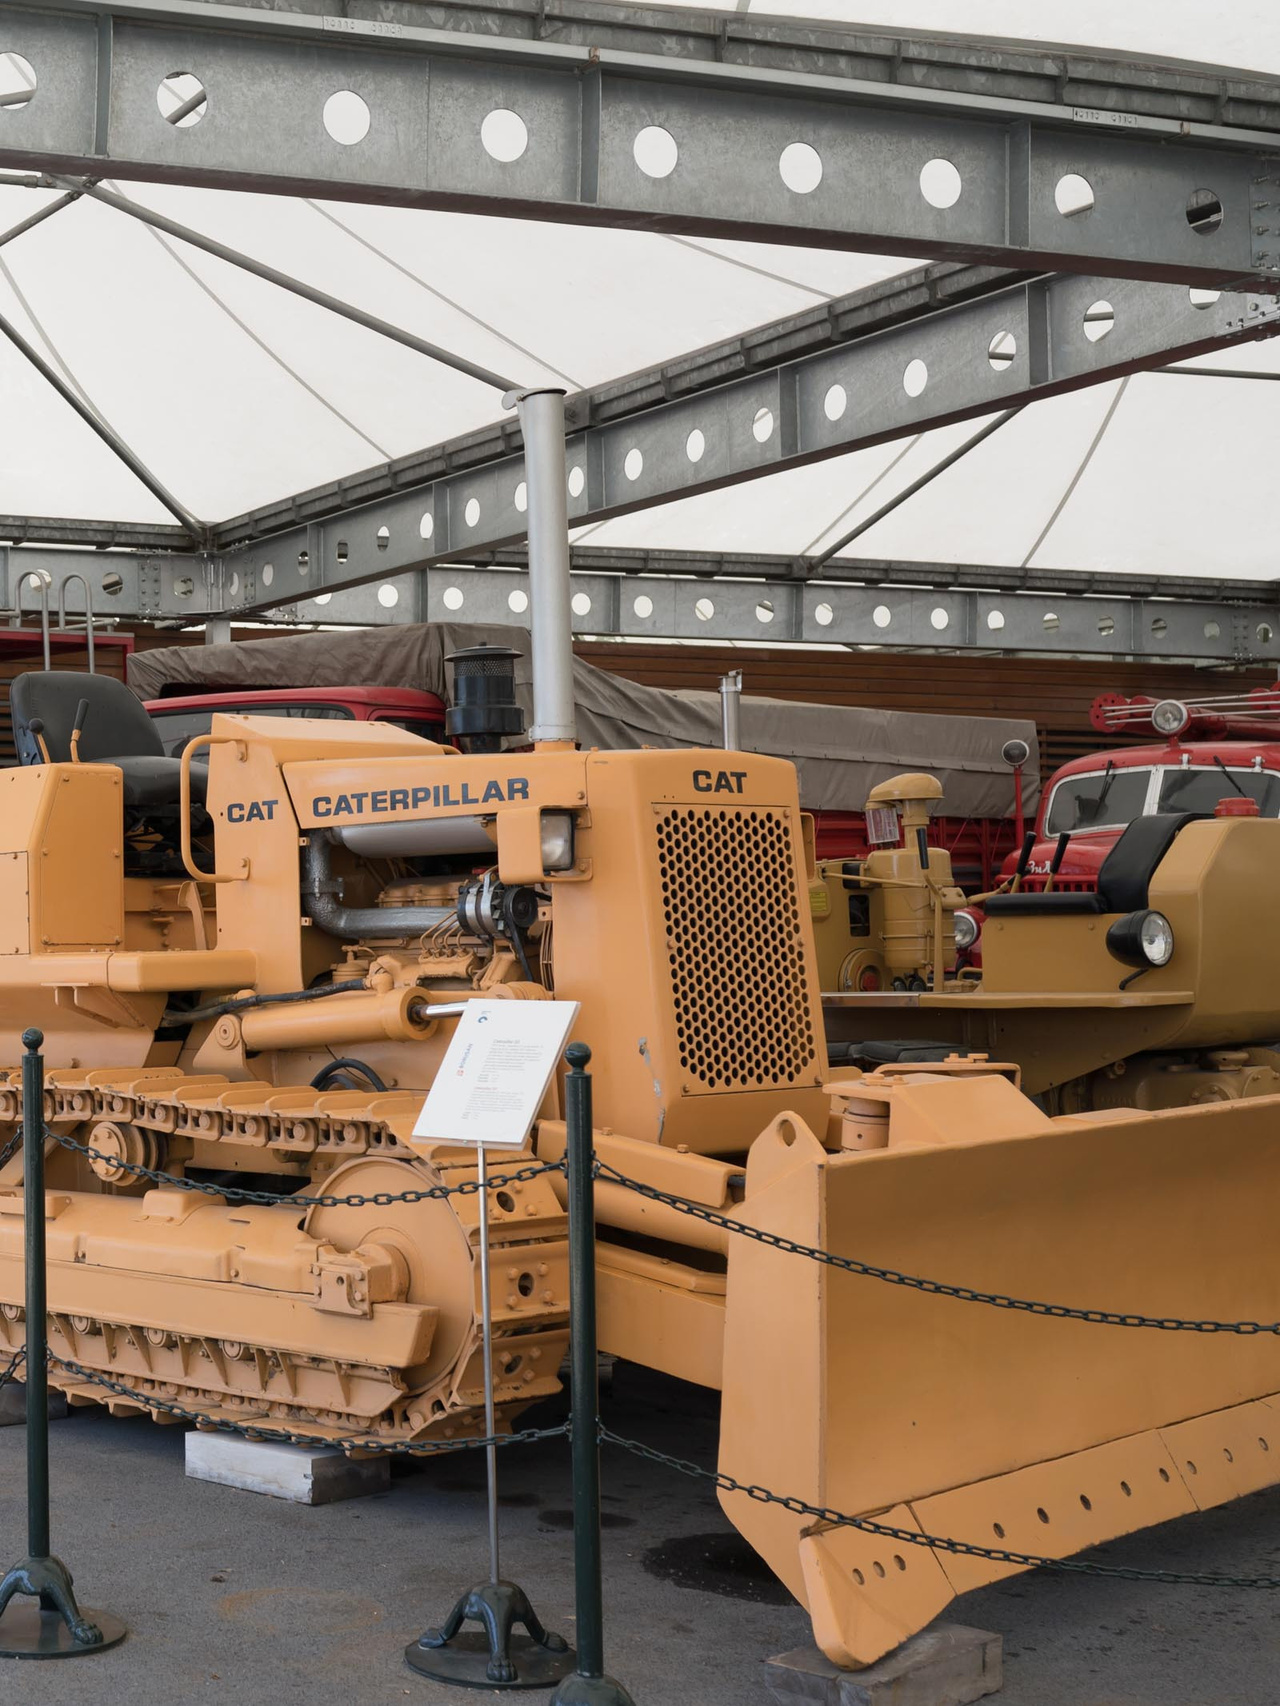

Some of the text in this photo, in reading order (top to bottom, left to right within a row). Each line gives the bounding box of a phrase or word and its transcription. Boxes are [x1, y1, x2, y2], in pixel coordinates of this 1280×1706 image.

[693, 769, 747, 794] CAT
[312, 777, 530, 818] CATERPILLAR
[227, 799, 279, 824] CAT
